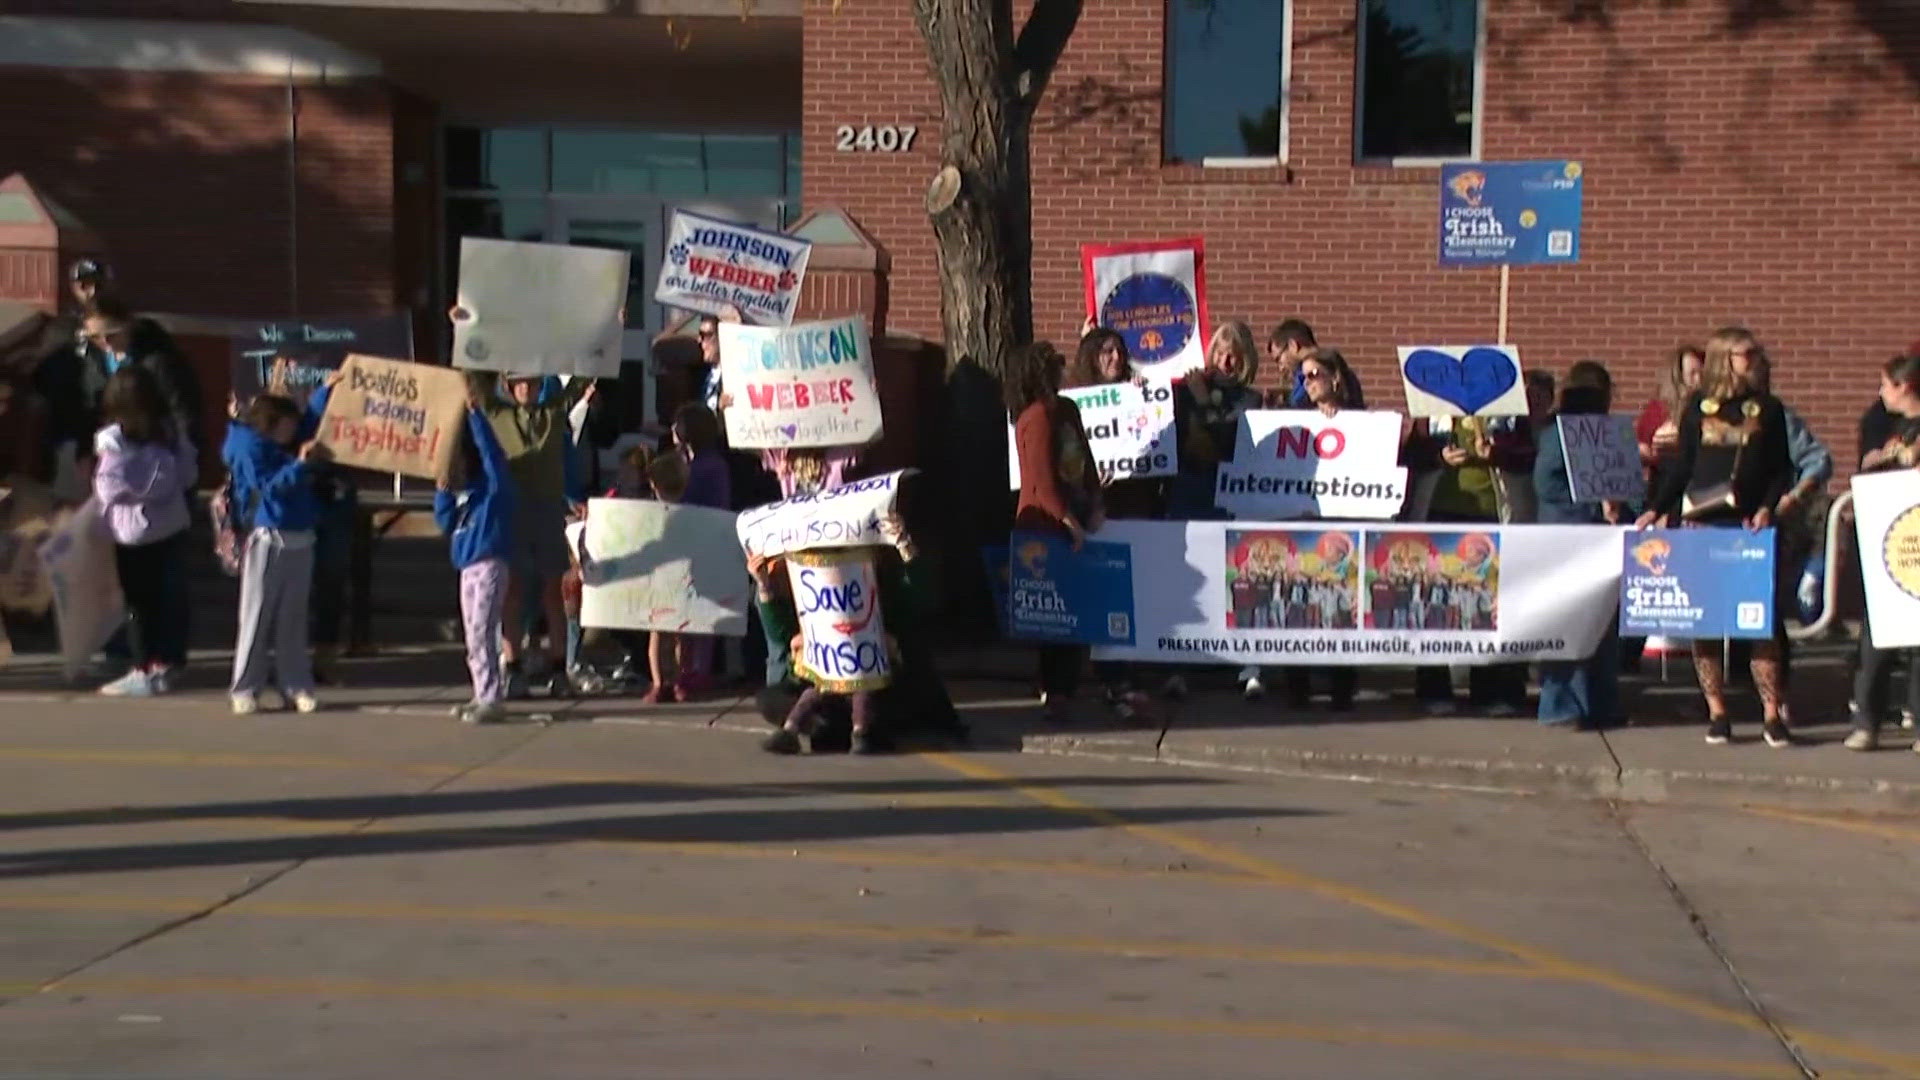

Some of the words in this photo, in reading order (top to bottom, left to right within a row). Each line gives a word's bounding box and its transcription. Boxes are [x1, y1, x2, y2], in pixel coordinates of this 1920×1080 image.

[836, 125, 917, 152] 2407
[1444, 215, 1504, 236] Irish
[1451, 206, 1494, 218] CHOOSE
[685, 227, 791, 267] JOHNSON
[1444, 235, 1517, 249] Elementary
[689, 256, 776, 294] WEBBER
[665, 275, 687, 290] are
[691, 277, 728, 299] better
[731, 287, 790, 315] together!
[738, 323, 858, 374] JOHNSON
[746, 378, 855, 411] WEBBER
[1142, 384, 1170, 402] to
[331, 415, 440, 460] Together!
[1276, 426, 1346, 460] NO
[1219, 472, 1402, 500] Interruptions.
[800, 569, 864, 613] Save
[1633, 575, 1679, 587] CHOOSE
[1014, 588, 1066, 612] Irish
[1626, 585, 1690, 607] Irish
[1626, 606, 1704, 621] Elementary
[1157, 637, 1229, 651] PRESERVA
[1233, 638, 1250, 652] LA
[1255, 636, 1337, 655] EDUCACIÓN
[1341, 637, 1415, 656] BILINGÜE,
[1420, 639, 1474, 654] HONRA
[1478, 641, 1497, 655] LA
[1501, 638, 1566, 656] EQUIDAD
